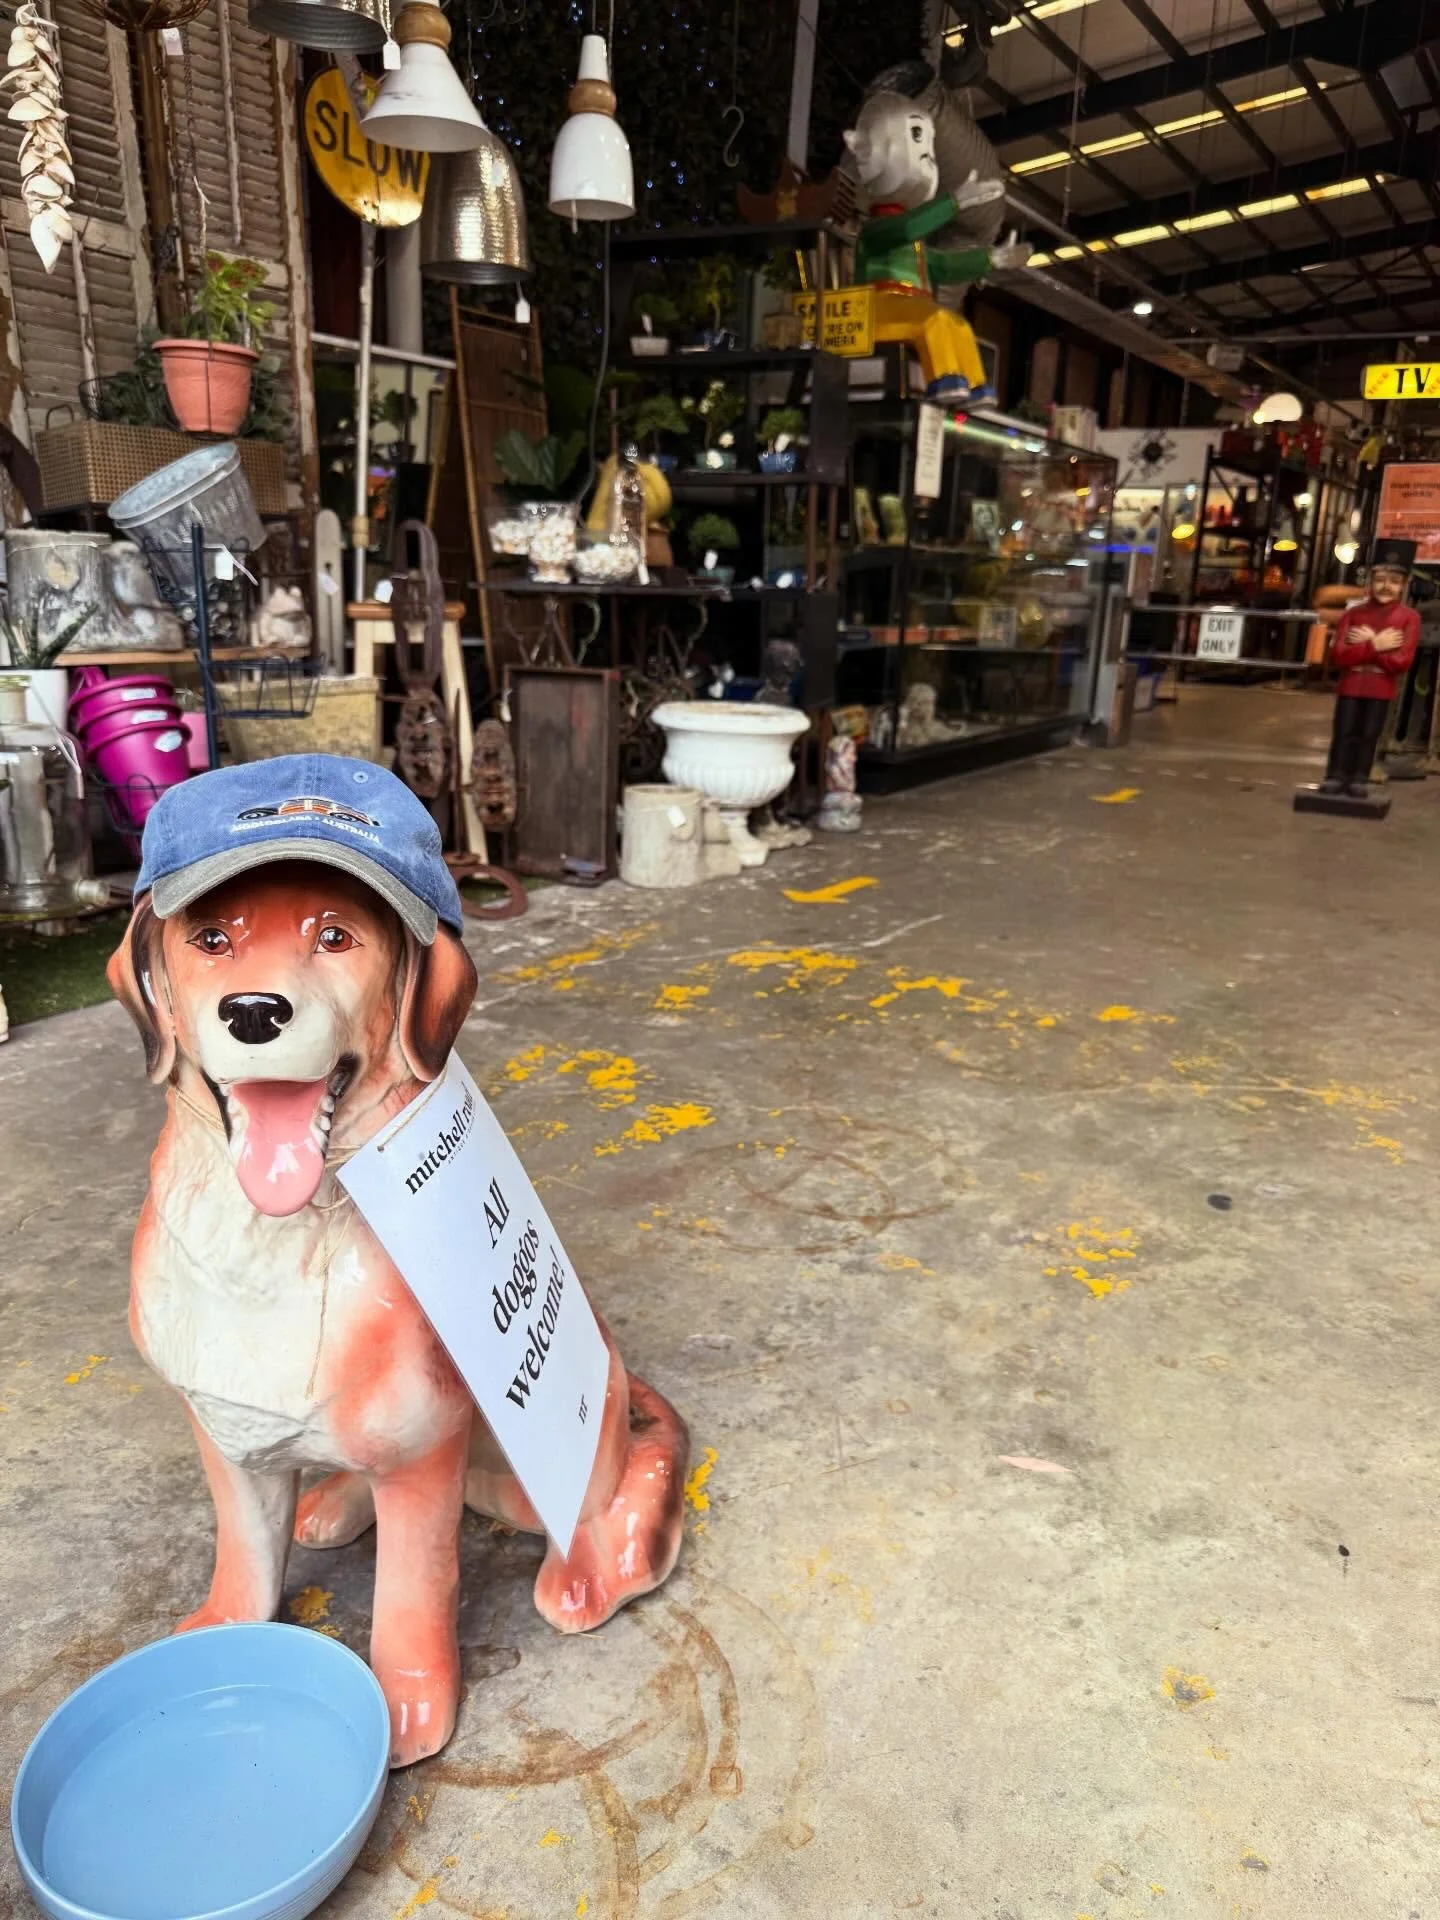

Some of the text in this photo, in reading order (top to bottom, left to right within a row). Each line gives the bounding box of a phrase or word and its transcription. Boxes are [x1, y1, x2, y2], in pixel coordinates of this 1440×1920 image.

[313, 100, 425, 193] SLOW
[1394, 367, 1432, 394] TV
[1201, 639, 1236, 654] ONLY
[1208, 617, 1236, 633] EXIT
[405, 1109, 467, 1195] mitchell
[483, 1176, 510, 1249] All
[492, 1219, 540, 1334] doggos
[506, 1245, 565, 1409] welcome!
